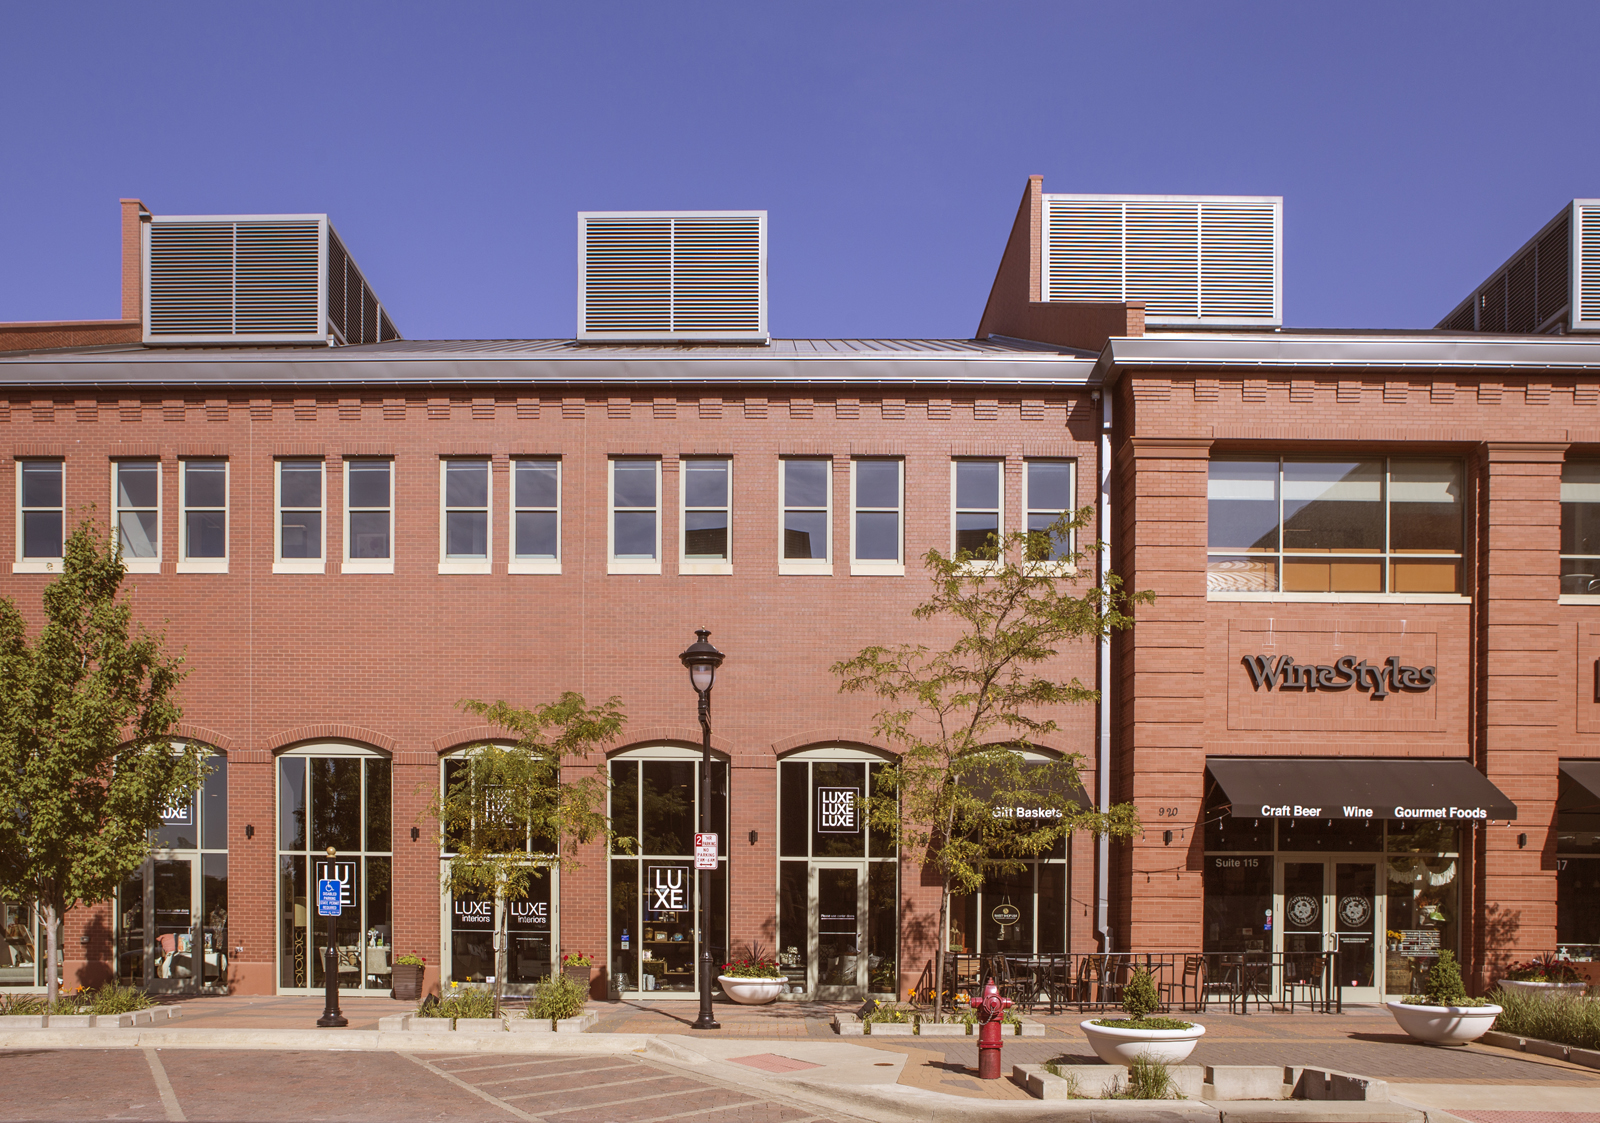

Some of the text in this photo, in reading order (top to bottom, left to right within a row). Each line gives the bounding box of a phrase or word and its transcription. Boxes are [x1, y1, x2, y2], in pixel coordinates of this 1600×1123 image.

[1241, 654, 1436, 700] WineStyles
[822, 791, 854, 803] LUXE
[822, 803, 854, 815] LUXE
[1016, 807, 1063, 818] Baskets
[1158, 807, 1178, 817] 920
[1261, 805, 1322, 817] Craft Beer
[1343, 806, 1374, 817] Wine
[1394, 806, 1487, 818] Gourmet Foods
[822, 814, 854, 827] LUXE
[696, 836, 702, 845] 2
[1215, 858, 1259, 868] Suite 115
[455, 901, 491, 915] LUXE
[511, 902, 547, 916] LUXE
[462, 915, 491, 923] interiors
[518, 916, 546, 924] interiors
